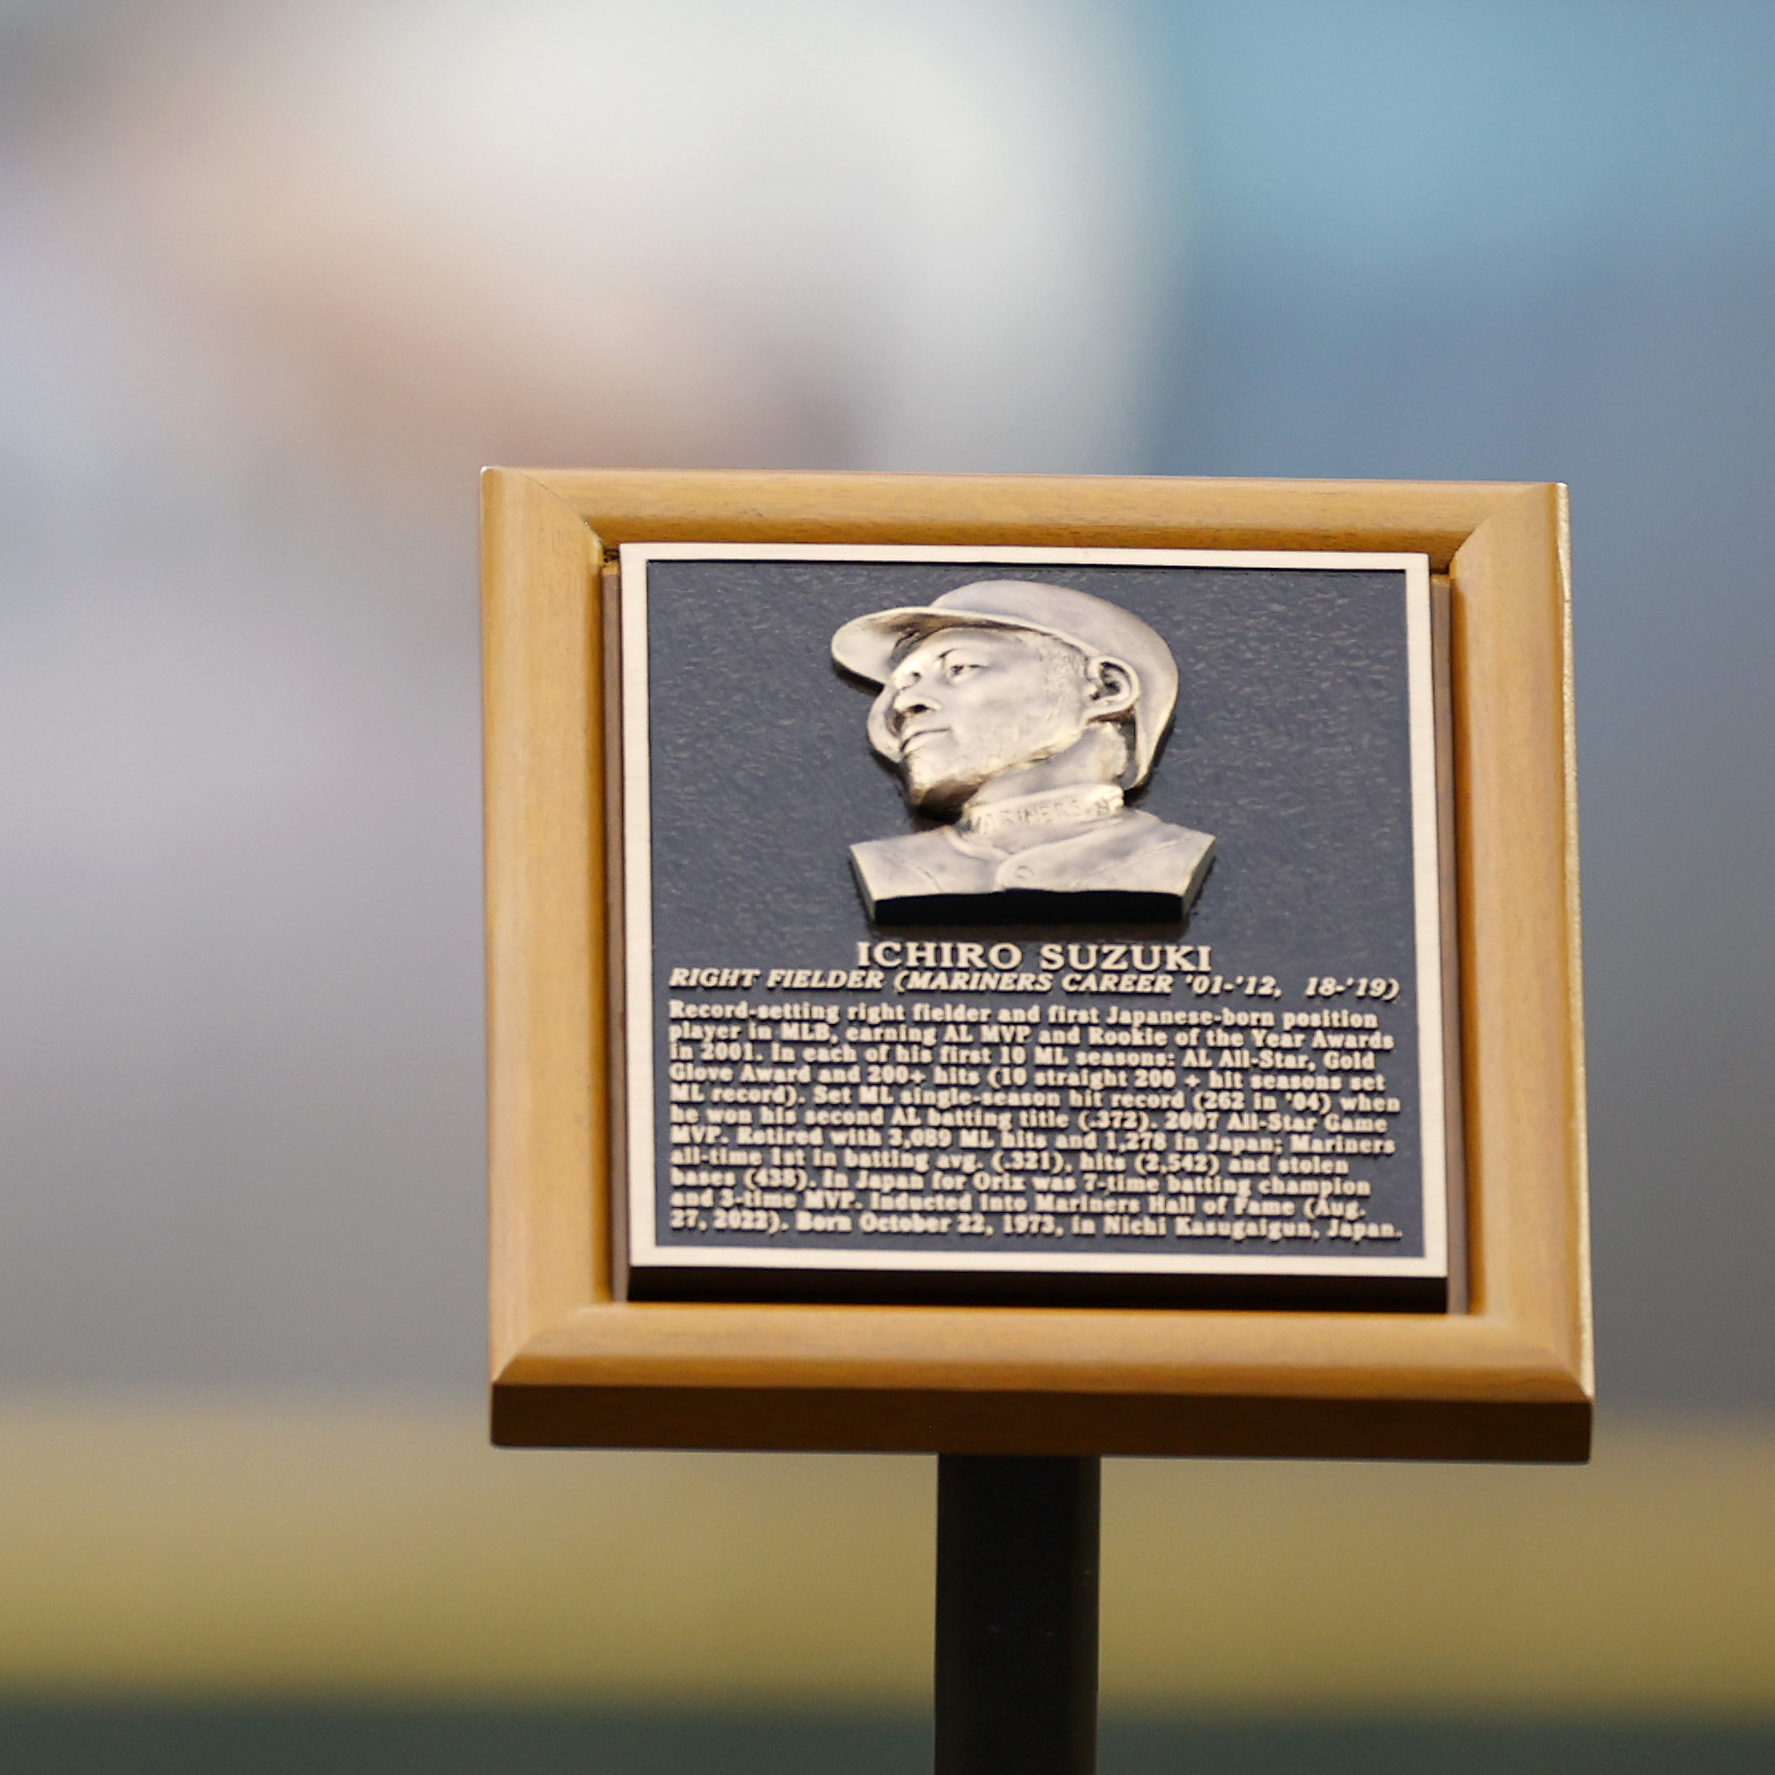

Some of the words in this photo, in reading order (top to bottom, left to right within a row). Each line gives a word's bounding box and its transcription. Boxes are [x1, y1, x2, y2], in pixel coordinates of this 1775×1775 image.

[856, 941, 1023, 970] ICHIRO
[1039, 943, 1212, 973] SUZUKI
[668, 967, 760, 988] RIGHT
[765, 968, 885, 989] FIELDER
[893, 970, 1054, 993] (MARINERS
[1061, 972, 1174, 993] CAREER
[668, 999, 841, 1024] Record-setting
[847, 1002, 906, 1025] right
[911, 1002, 992, 1022] fielder
[997, 1004, 1041, 1023] and
[1047, 1004, 1100, 1024] first
[1105, 1006, 1276, 1028] Japanese-born
[1281, 1008, 1379, 1030] position
[668, 1021, 742, 1042] player
[749, 1021, 773, 1041] in
[779, 1022, 840, 1045] MLB,
[845, 1024, 937, 1046] earning
[943, 1025, 974, 1043] AL
[979, 1025, 1032, 1044] MVP
[1037, 1026, 1082, 1045] and
[1087, 1027, 1169, 1046] Rookie
[1174, 1028, 1200, 1047] of
[1205, 1029, 1245, 1047] the
[1250, 1029, 1306, 1049] Year
[1311, 1030, 1395, 1050] Awards
[669, 1042, 694, 1061] in
[700, 1042, 764, 1062] 2001.
[770, 1043, 796, 1063] In
[801, 1044, 858, 1063] each
[863, 1044, 891, 1064] of
[895, 1045, 933, 1064] his
[938, 1045, 992, 1065] first
[1000, 1046, 1028, 1065] 10
[1033, 1047, 1070, 1066] ML
[1074, 1049, 1175, 1067] seasons:
[1181, 1049, 1213, 1068] AL
[1217, 1049, 1317, 1072] All-Star,
[1322, 1051, 1376, 1071] Gold
[668, 1062, 734, 1082] Glove
[740, 1064, 812, 1083] Award
[817, 1064, 861, 1083] and
[932, 1066, 981, 1085] hits
[986, 1067, 1028, 1090] (10
[1033, 1068, 1128, 1091] straight
[1133, 1069, 1177, 1088] 200
[1208, 1069, 1244, 1089] hit
[1250, 1073, 1342, 1091] seasons
[1349, 1073, 1386, 1092] set
[669, 1083, 705, 1103] ML
[710, 1084, 807, 1107] record).
[812, 1085, 852, 1105] Set
[858, 1085, 894, 1105] ML
[901, 1087, 1061, 1109] single-season
[1068, 1089, 1103, 1108] hit
[1110, 1090, 1186, 1109] record
[1192, 1091, 1245, 1112] (262
[1253, 1092, 1278, 1111] in
[1284, 1092, 1333, 1114] '04)
[1339, 1093, 1401, 1113] when
[669, 1104, 699, 1124] he
[705, 1107, 753, 1125] won
[759, 1105, 797, 1125] his
[804, 1107, 885, 1126] second
[890, 1106, 921, 1126] AL
[926, 1107, 1013, 1130] batting
[1018, 1109, 1069, 1128] title
[1076, 1110, 1158, 1132] (.372).
[1164, 1111, 1220, 1131] 2007
[1226, 1112, 1318, 1132] All-Star
[1323, 1114, 1389, 1133] Game
[669, 1125, 729, 1145] MVP.
[735, 1126, 824, 1146] Retired
[829, 1128, 883, 1146] with
[887, 1128, 952, 1149] 3,089
[958, 1129, 995, 1149] ML
[1000, 1129, 1048, 1149] hits
[1054, 1130, 1098, 1150] and
[1105, 1131, 1168, 1152] 1,278
[1174, 1133, 1200, 1152] in
[1205, 1133, 1284, 1156] Japan;
[1289, 1134, 1396, 1154] Mariners
[669, 1145, 763, 1166] all-time
[770, 1146, 807, 1166] 1st
[812, 1147, 838, 1167] in
[843, 1148, 930, 1172] batting
[935, 1152, 984, 1173] avg.
[1078, 1151, 1127, 1172] hits
[1134, 1153, 1221, 1175] (2,542)
[1227, 1155, 1271, 1174] and
[1277, 1155, 1350, 1175] stolen
[669, 1166, 736, 1187] bases
[742, 1167, 817, 1191] (438).
[822, 1169, 849, 1189] In
[854, 1169, 925, 1193] Japan
[931, 1171, 967, 1190] for
[972, 1172, 1026, 1191] Orix
[1031, 1174, 1077, 1192] was
[1082, 1173, 1160, 1194] 7-time
[1167, 1175, 1252, 1198] batting
[1257, 1176, 1372, 1199] champion
[669, 1188, 715, 1208] and
[719, 1188, 798, 1209] 3-time
[803, 1189, 864, 1210] MVP.
[869, 1190, 973, 1211] Inducted
[978, 1192, 1028, 1212] into
[1033, 1193, 1141, 1214] Mariners
[1148, 1195, 1196, 1215] Hall
[1202, 1196, 1229, 1216] of
[1233, 1197, 1296, 1216] Fame
[1303, 1198, 1367, 1221] (Aug.
[669, 1208, 707, 1231] 27,
[712, 1209, 789, 1234] 2022).
[794, 1211, 853, 1232] Born
[858, 1211, 952, 1233] October
[956, 1213, 995, 1236] 22,
[1001, 1213, 1065, 1236] 1973,
[1070, 1215, 1097, 1235] in
[1102, 1216, 1167, 1236] Nichi
[1326, 1218, 1403, 1241] Japan.
